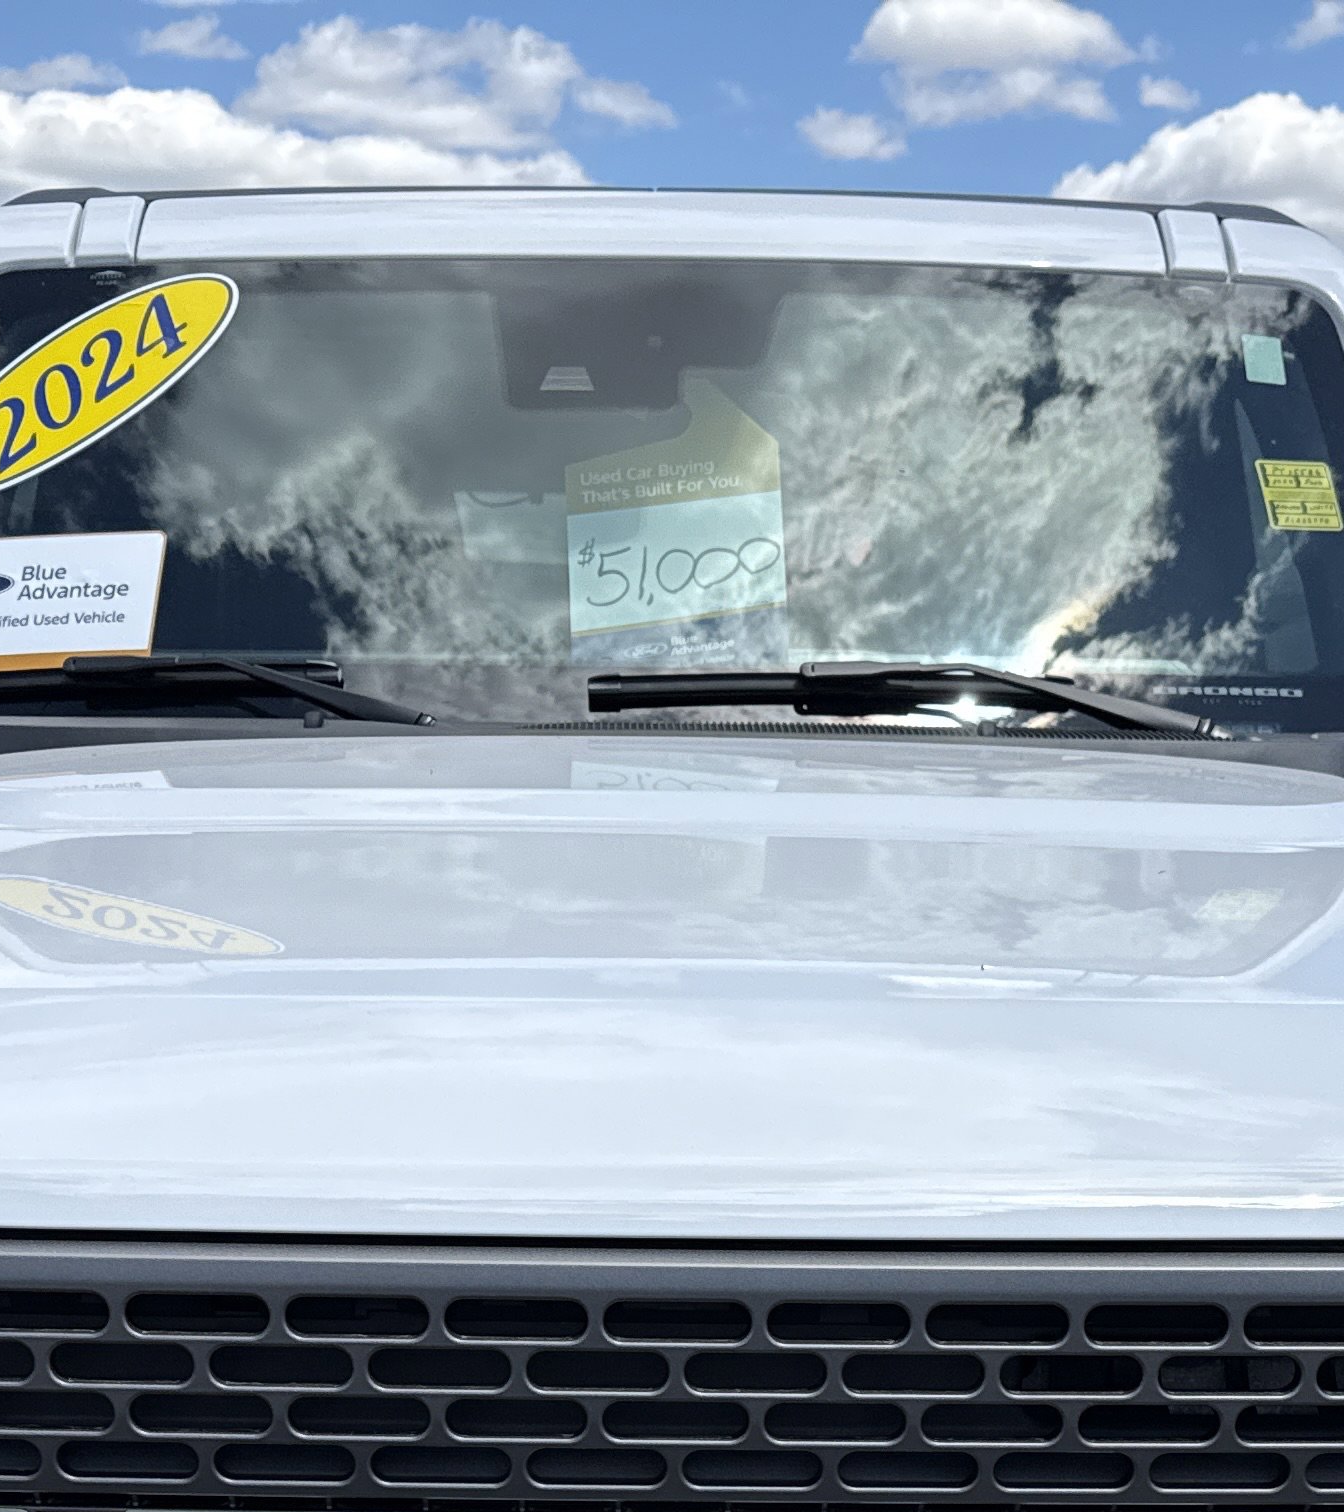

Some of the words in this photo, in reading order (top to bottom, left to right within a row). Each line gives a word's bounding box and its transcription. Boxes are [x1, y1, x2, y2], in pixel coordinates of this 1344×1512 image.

[580, 470, 621, 487] Used
[626, 466, 654, 482] Car
[658, 460, 715, 479] Buying
[581, 487, 630, 504] That's
[636, 481, 672, 498] Built
[678, 479, 703, 493] For
[21, 564, 67, 582] Blue
[578, 537, 781, 607] $51,000
[17, 581, 129, 601] Advantage
[34, 612, 70, 627] Used
[74, 610, 125, 625] Vehicle
